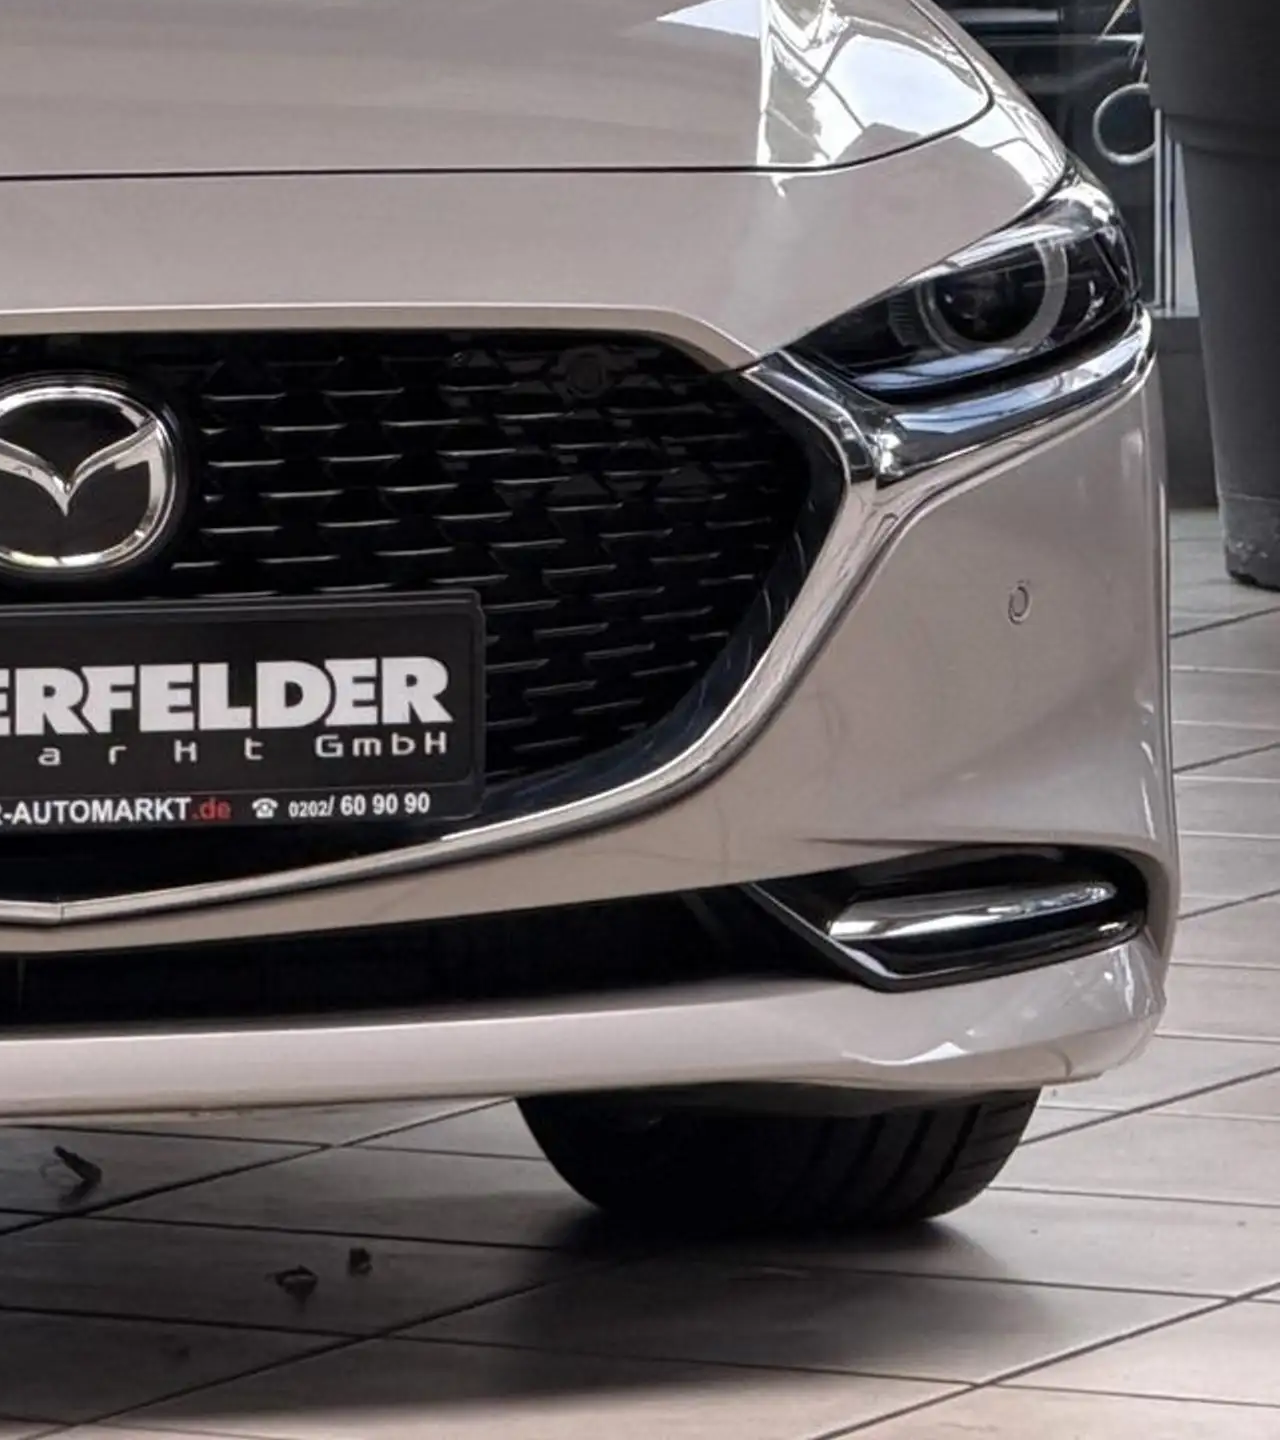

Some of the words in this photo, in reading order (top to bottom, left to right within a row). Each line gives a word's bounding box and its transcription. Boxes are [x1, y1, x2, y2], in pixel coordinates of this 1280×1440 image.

[314, 730, 448, 759] GmbH
[341, 793, 366, 816] 60
[372, 792, 398, 815] 90
[404, 791, 431, 814] 90
